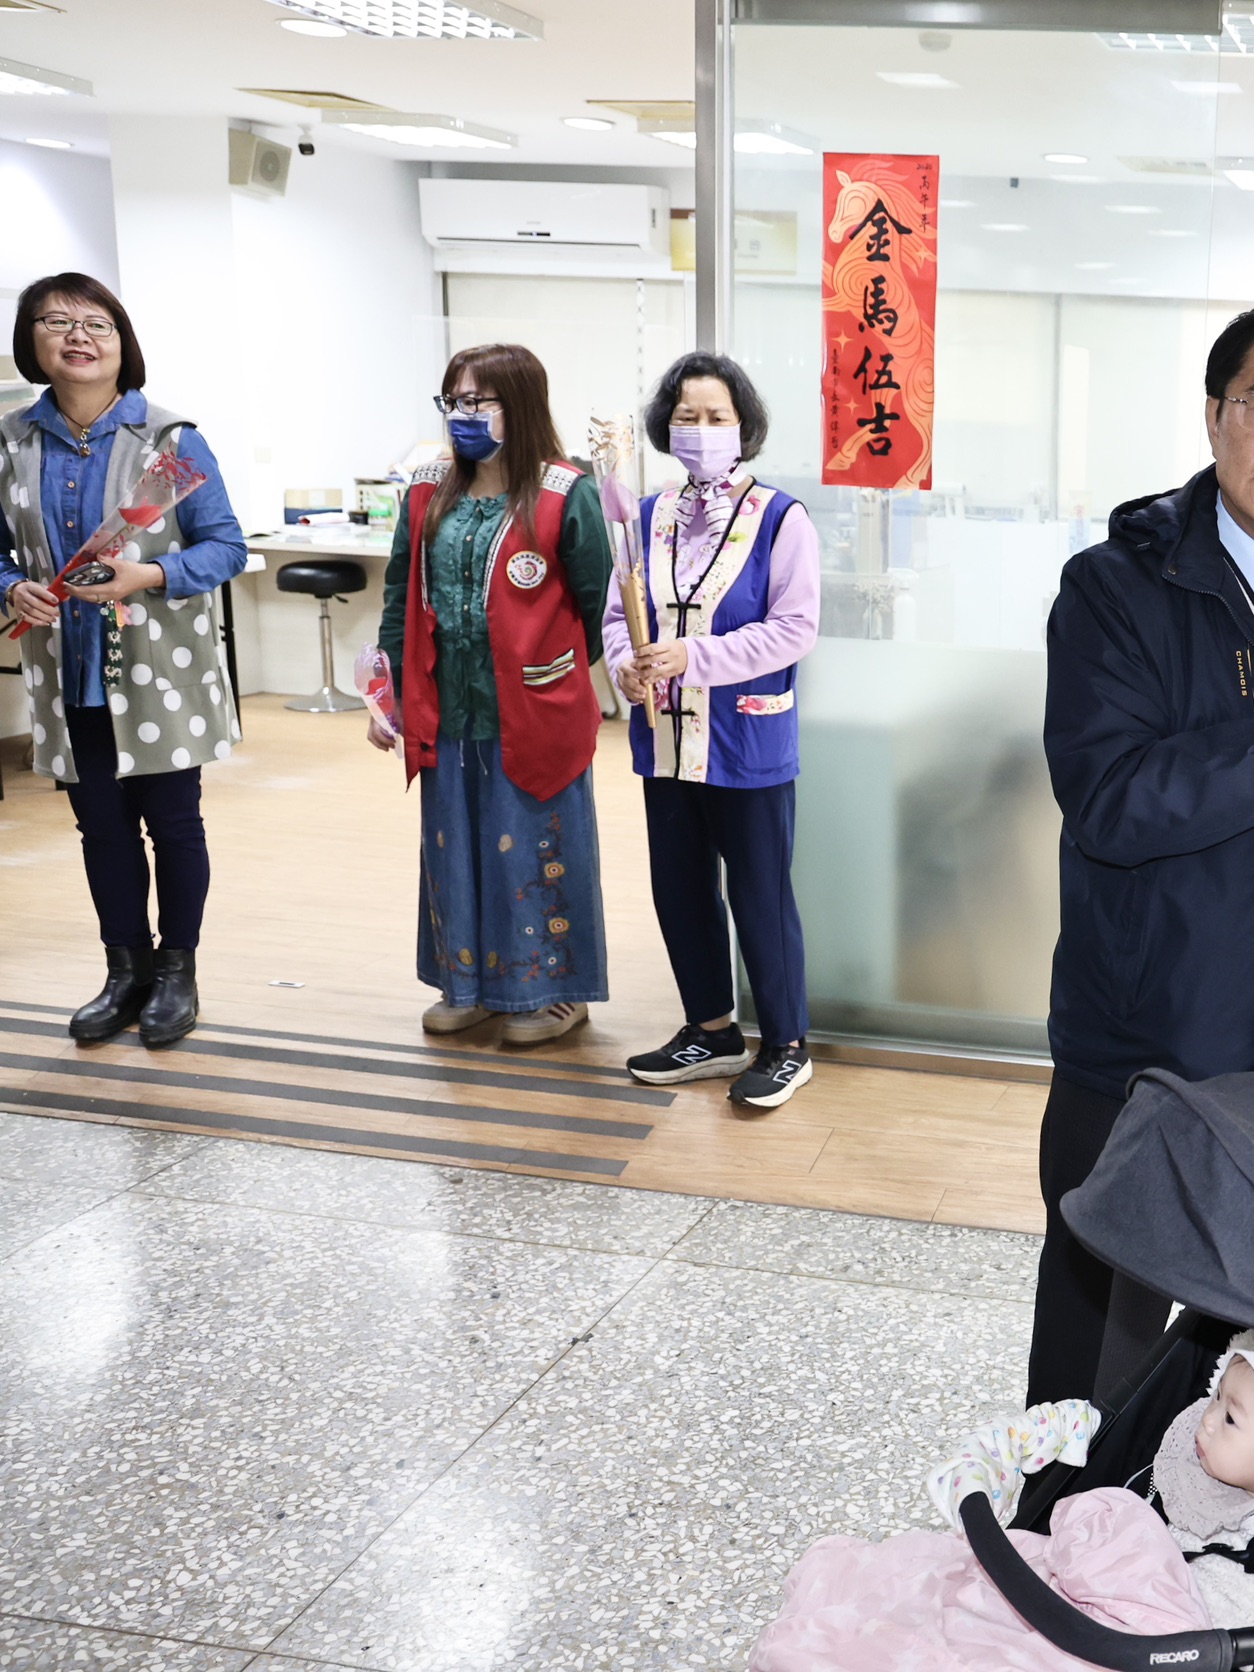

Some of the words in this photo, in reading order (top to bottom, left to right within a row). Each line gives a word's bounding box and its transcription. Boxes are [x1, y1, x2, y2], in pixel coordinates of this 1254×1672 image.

[849, 197, 913, 457] 金馬伍吉
[1235, 650, 1248, 696] CHAMOIS
[1149, 1649, 1200, 1666] RECARO
